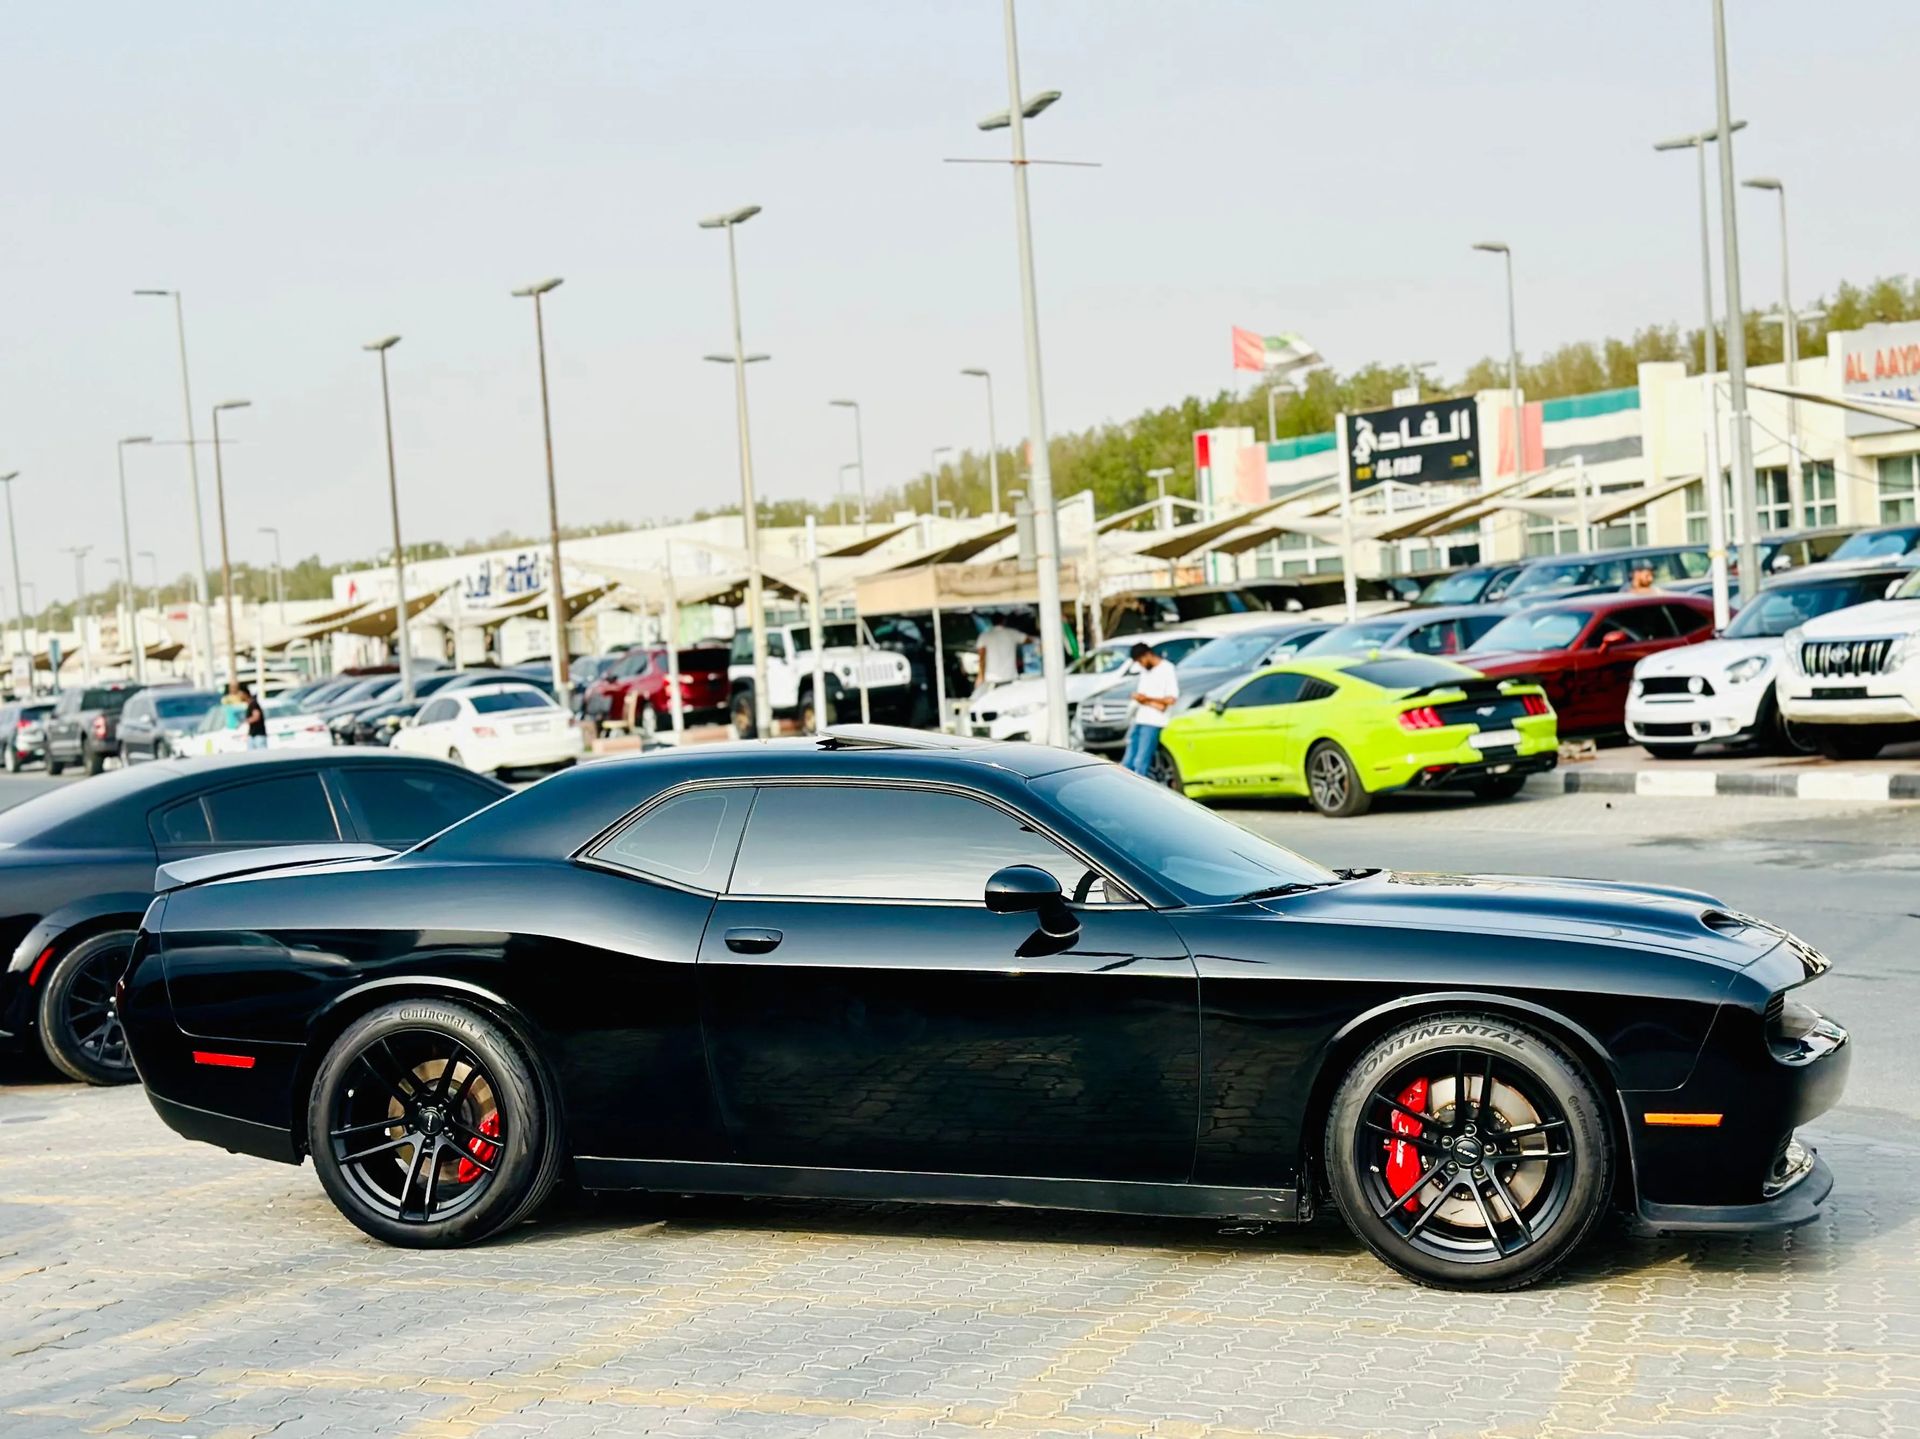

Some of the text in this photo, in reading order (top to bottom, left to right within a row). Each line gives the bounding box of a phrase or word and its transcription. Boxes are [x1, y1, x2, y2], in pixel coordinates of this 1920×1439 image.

[1844, 351, 1869, 384] AL
[400, 1008, 467, 1029] Continental
[1352, 1023, 1526, 1088] CONTINENTAL
